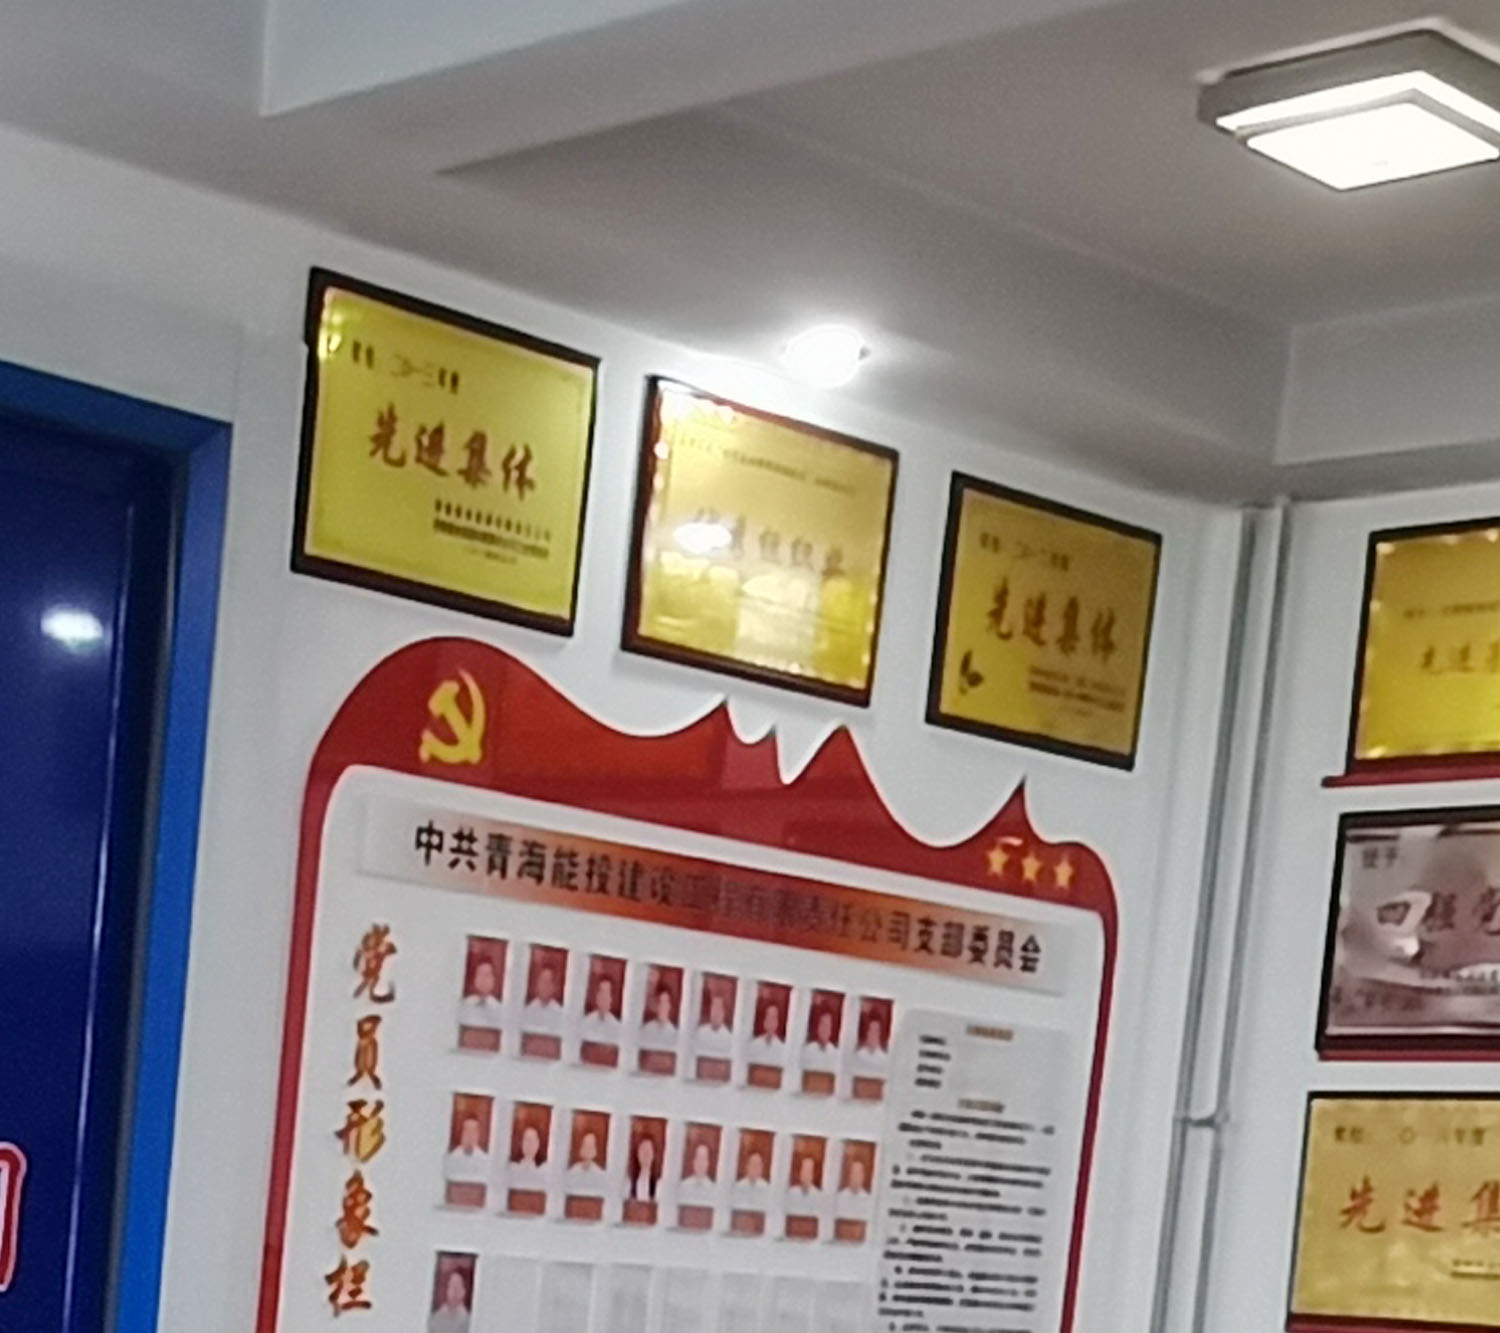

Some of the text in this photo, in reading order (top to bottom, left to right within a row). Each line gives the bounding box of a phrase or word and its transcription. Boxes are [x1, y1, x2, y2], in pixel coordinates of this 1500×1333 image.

[369, 402, 535, 500] 先进集体
[326, 924, 398, 1318] 党员形象栏
